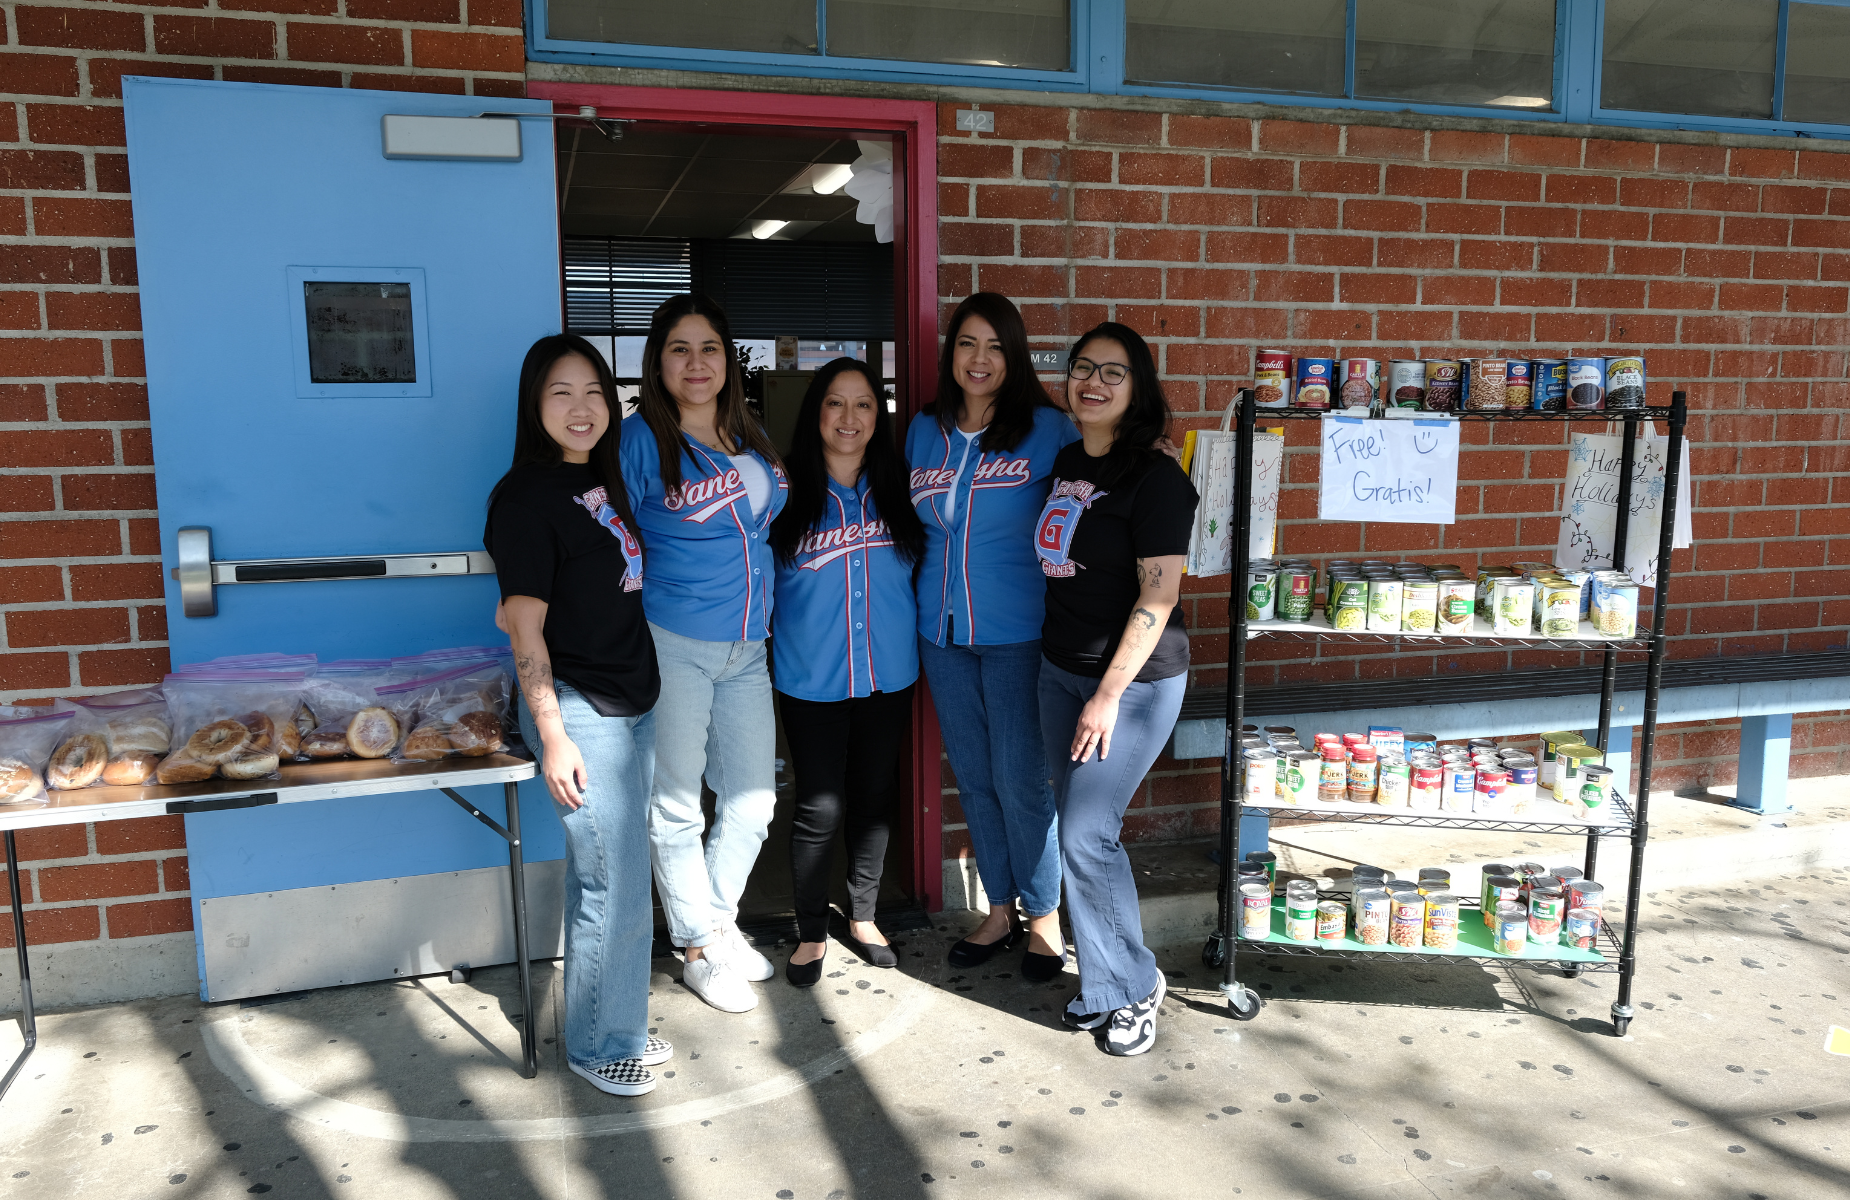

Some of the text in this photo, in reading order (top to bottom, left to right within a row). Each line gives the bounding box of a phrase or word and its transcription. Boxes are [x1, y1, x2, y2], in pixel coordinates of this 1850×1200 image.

[963, 113, 986, 130] 42
[1043, 353, 1057, 363] 42
[1328, 427, 1386, 464] Free!
[1353, 470, 1432, 505] Gratis!
[1038, 507, 1070, 552] G
[1042, 560, 1076, 577] GIANTS
[1371, 739, 1402, 748] JIFFY
[1247, 898, 1269, 908] ROYAL
